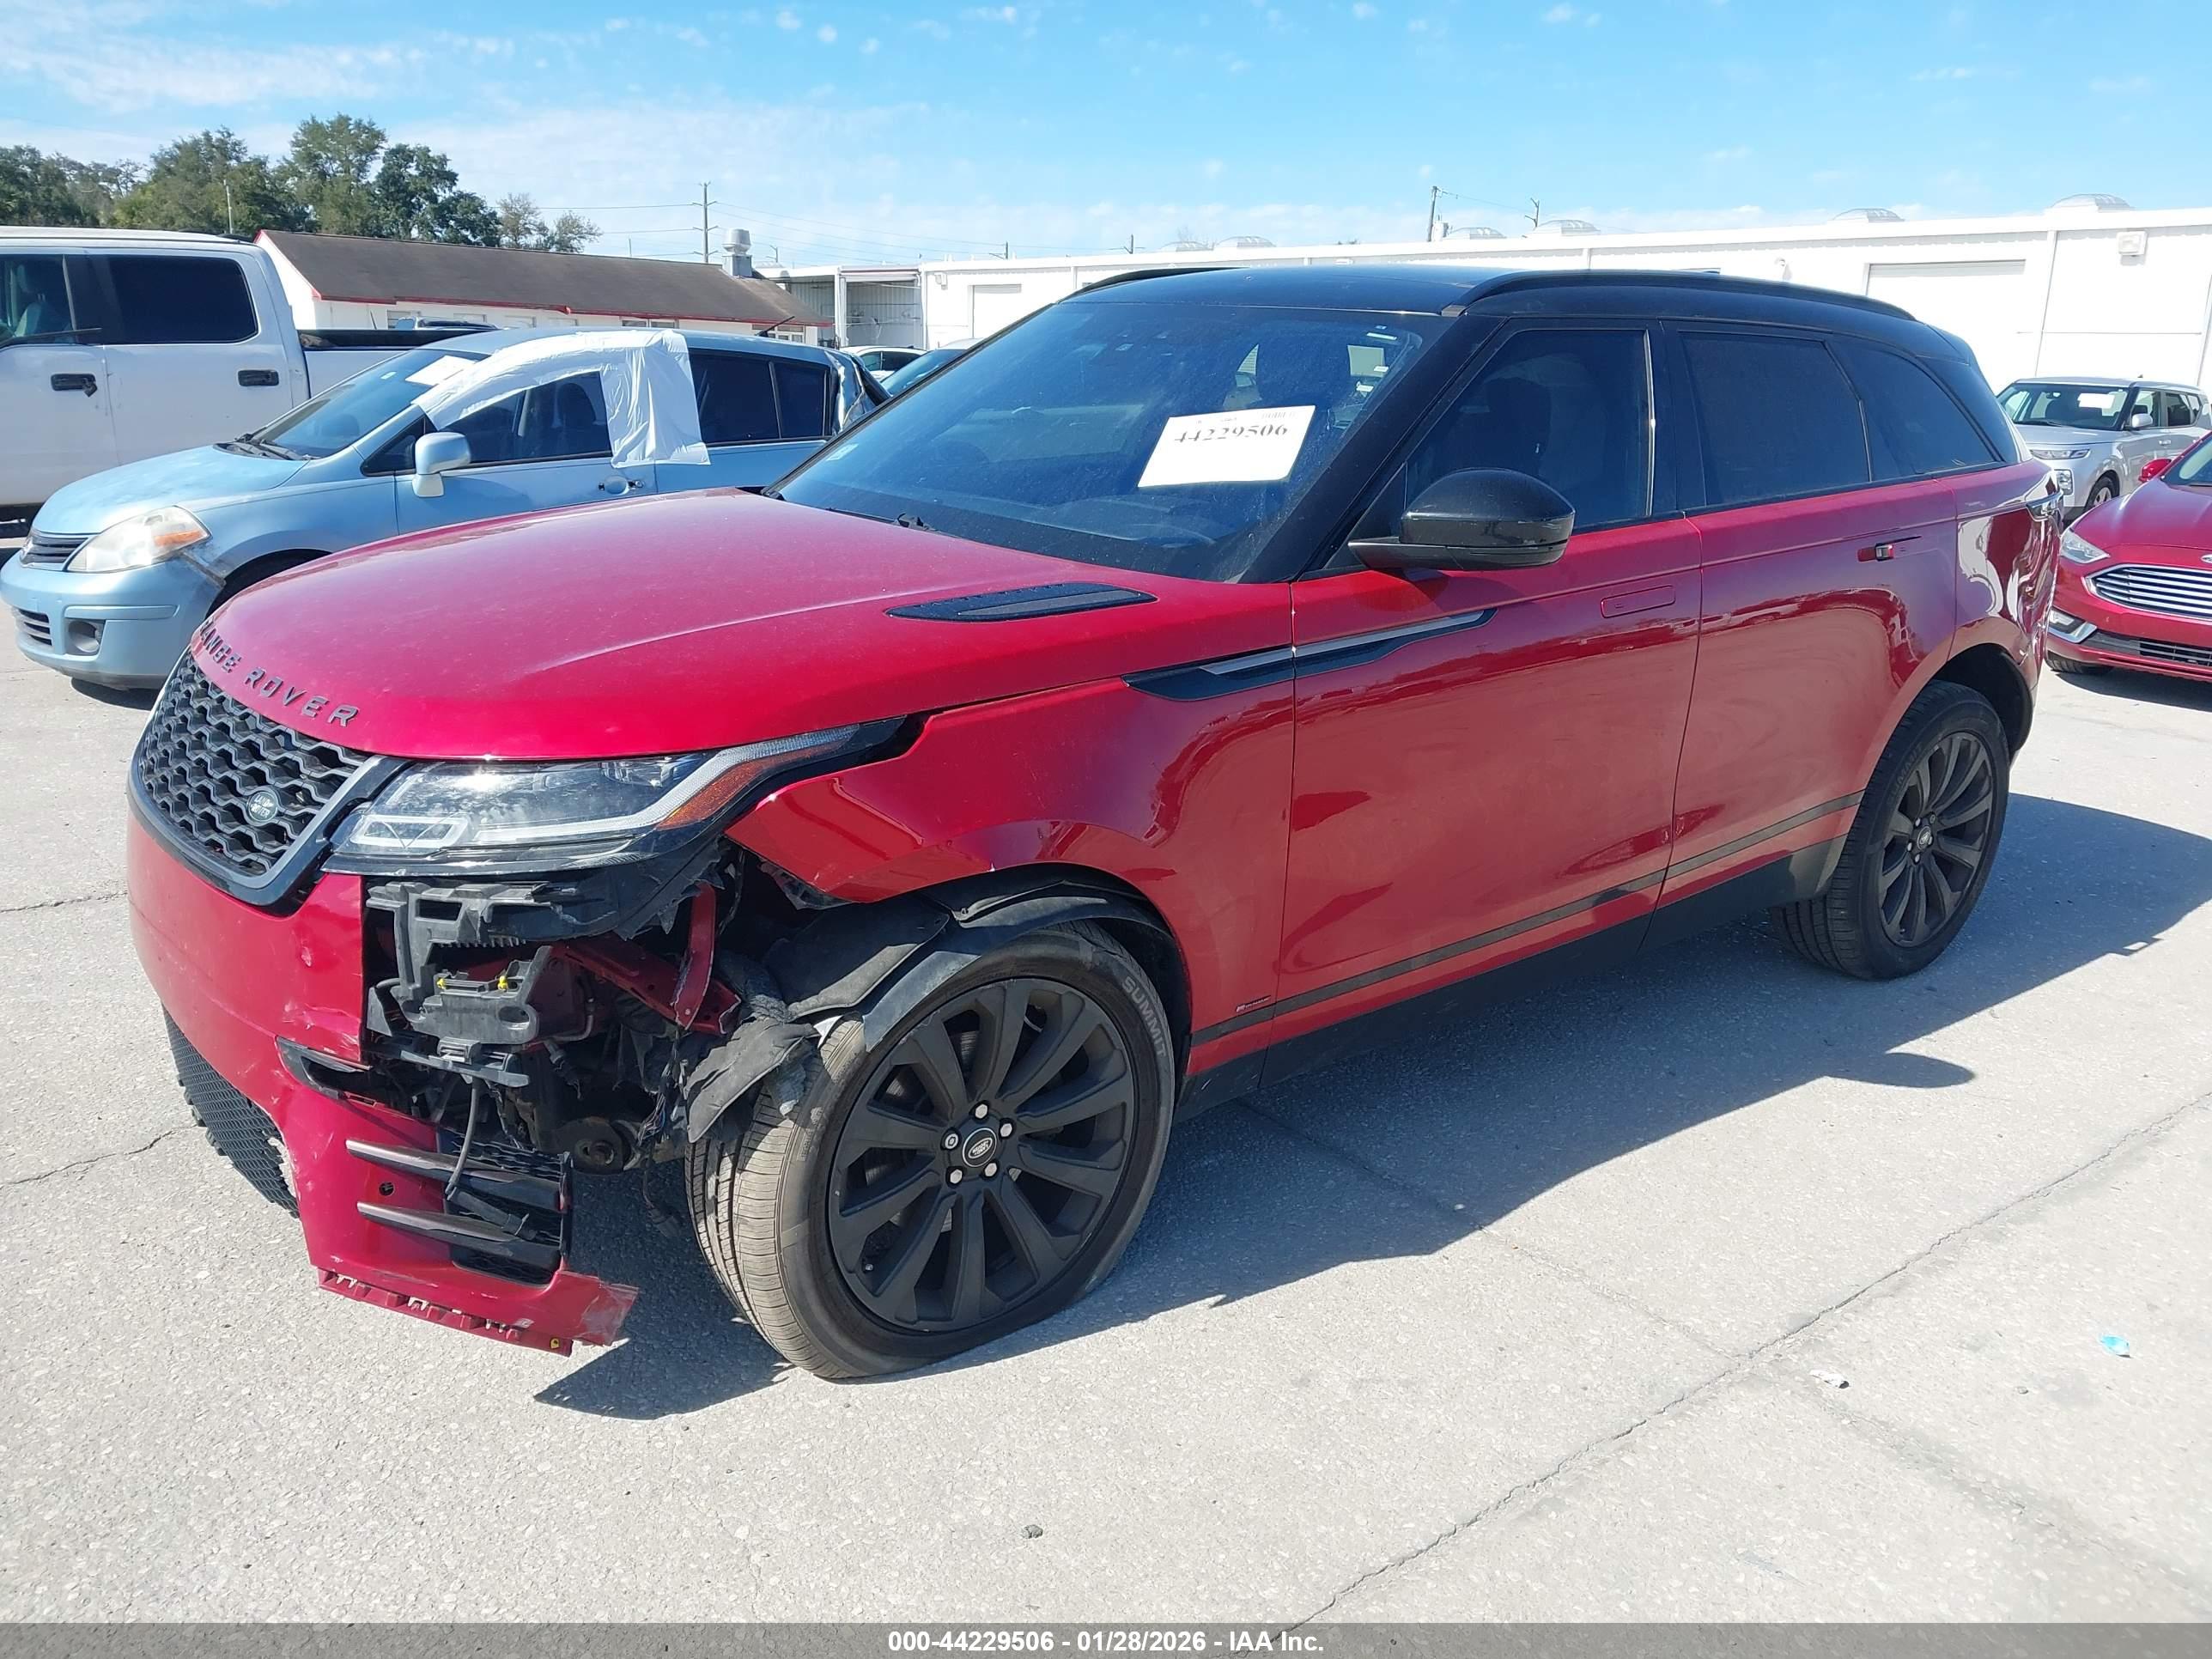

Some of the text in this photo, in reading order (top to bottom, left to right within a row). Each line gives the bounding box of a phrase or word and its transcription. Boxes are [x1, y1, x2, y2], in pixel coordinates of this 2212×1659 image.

[1175, 423, 1288, 443] 44229506
[200, 618, 361, 727] RANGE ROVER
[1121, 976, 1166, 1057] SUMMIT
